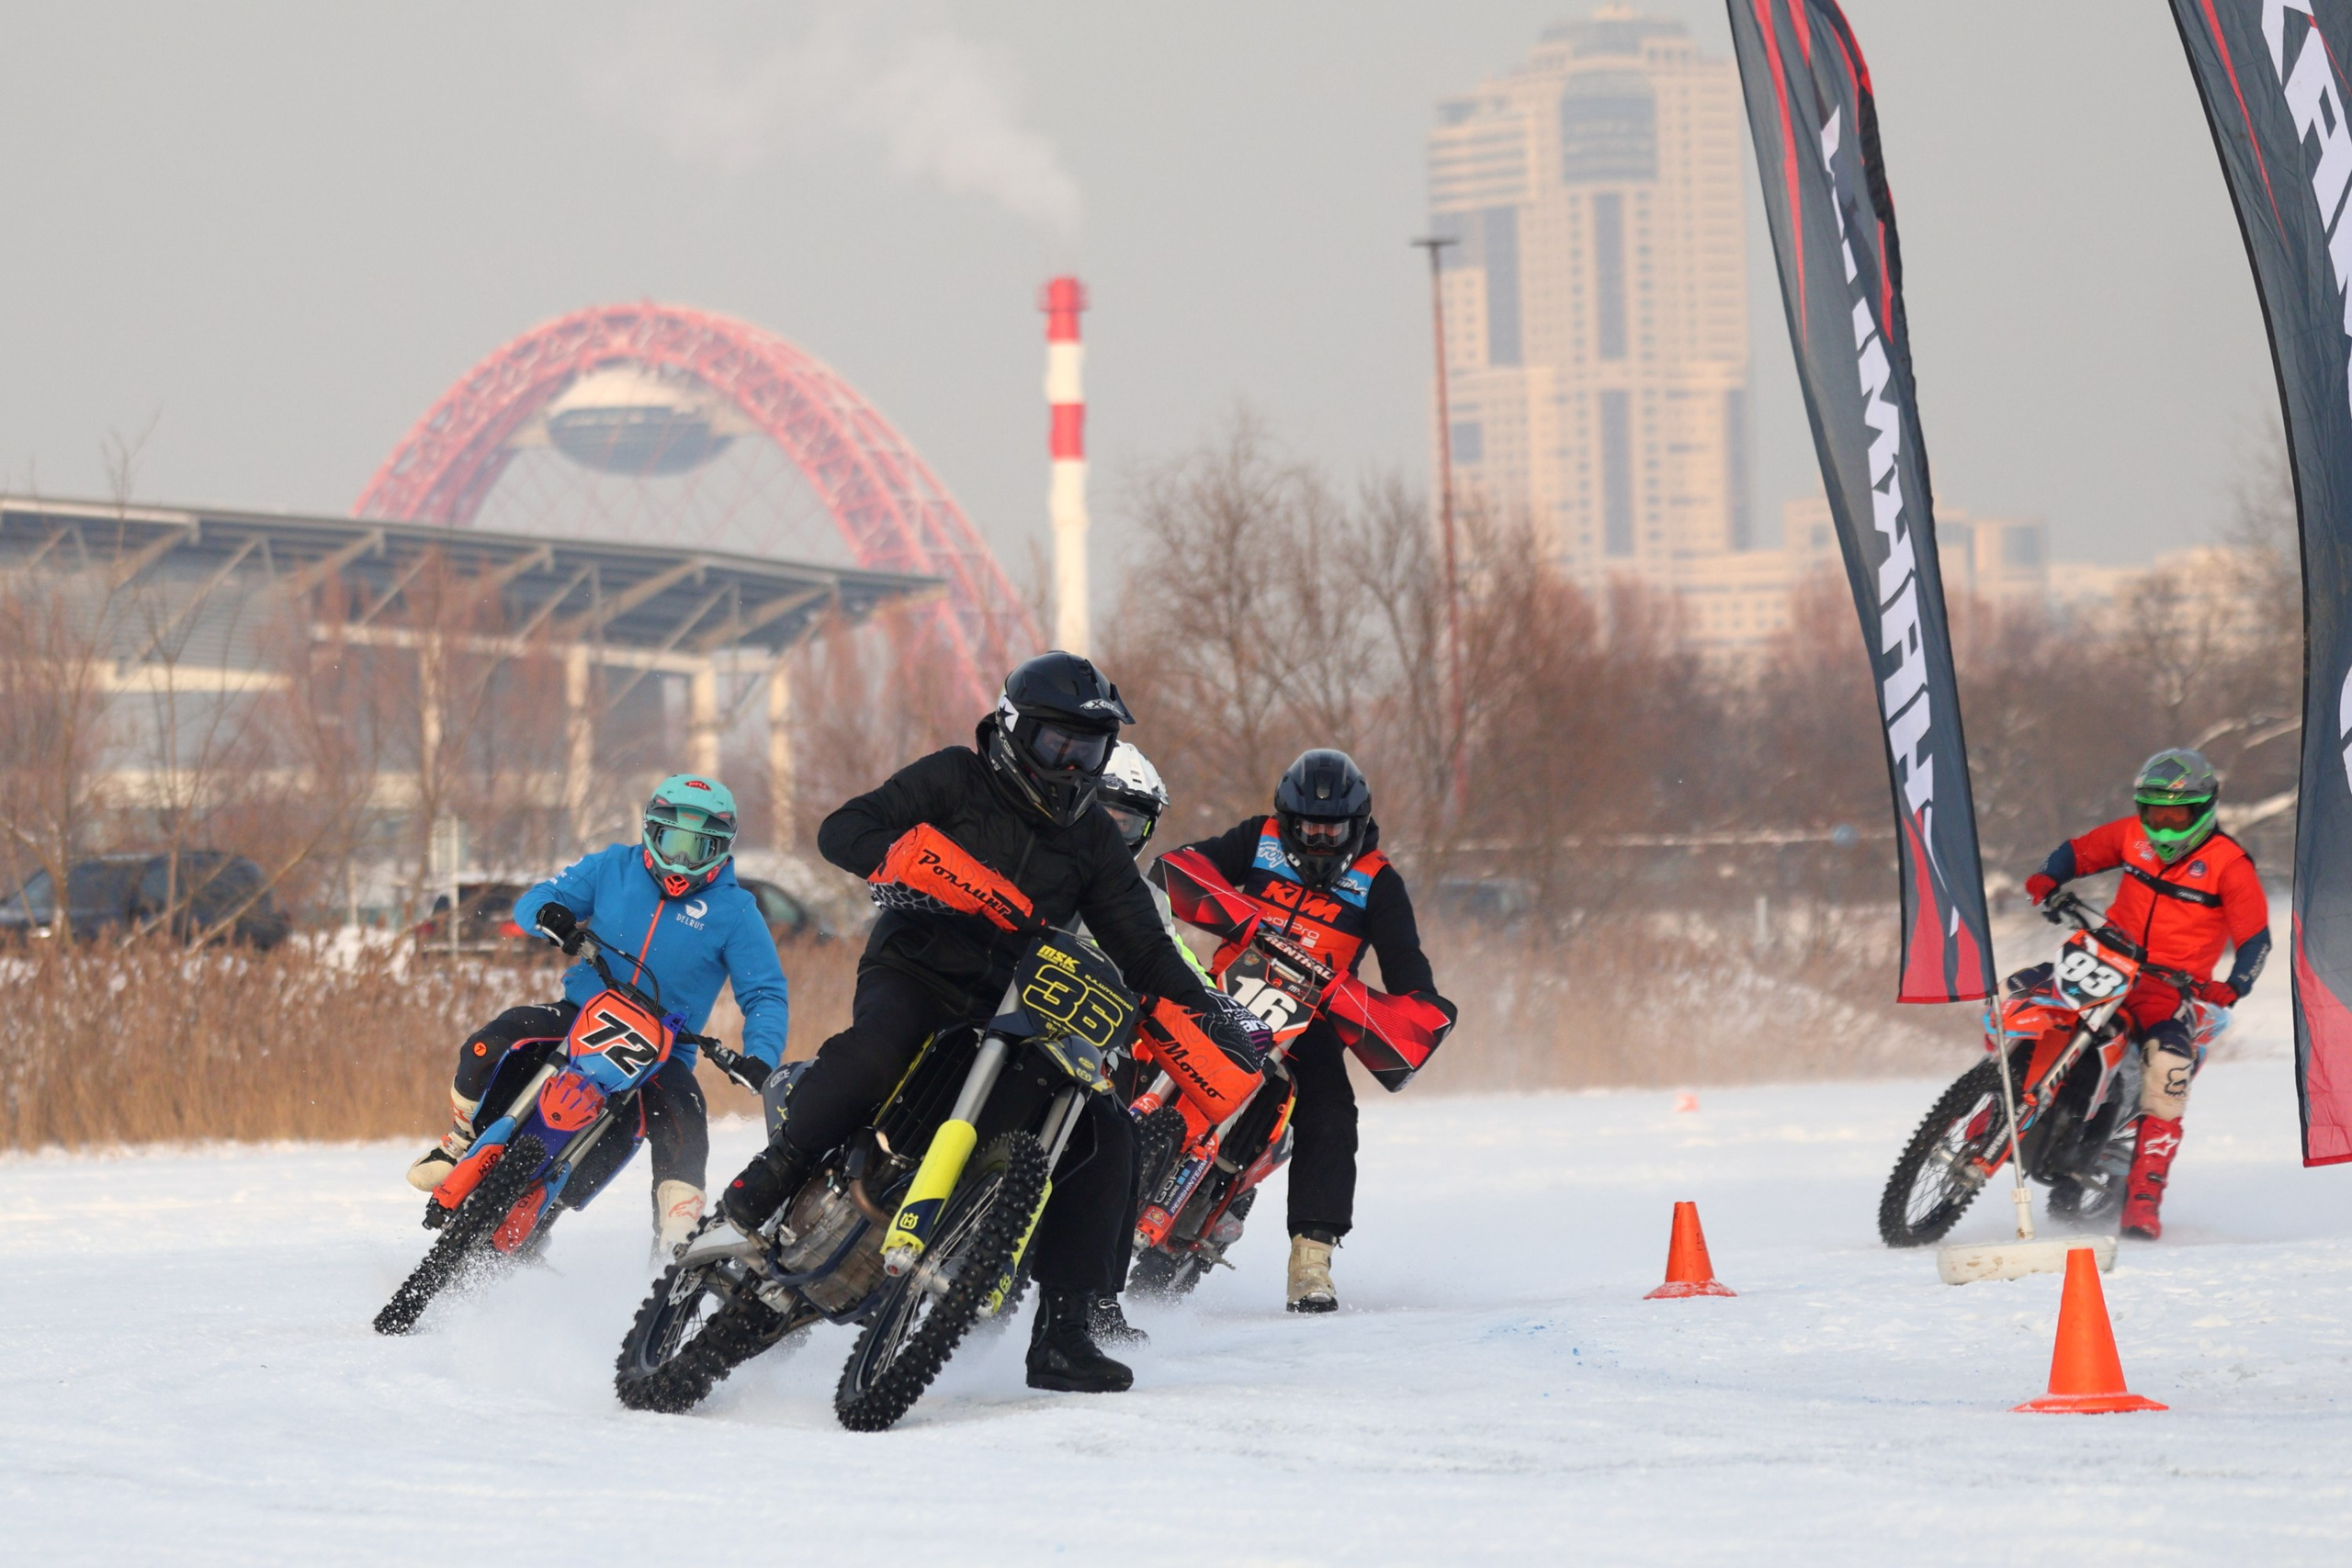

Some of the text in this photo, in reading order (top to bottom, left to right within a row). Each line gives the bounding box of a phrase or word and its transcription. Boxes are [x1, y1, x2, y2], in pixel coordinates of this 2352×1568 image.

[675, 913, 705, 931] DELRUS
[1261, 880, 1342, 923] KTM
[1038, 945, 1081, 970] MSK
[1264, 936, 1333, 980] RENTHAL
[2056, 952, 2124, 998] 93
[1023, 964, 1123, 1046] 36
[1231, 976, 1297, 1033] 16
[578, 1009, 660, 1078] 72
[1170, 1157, 1208, 1214] PERSHINTEAM
